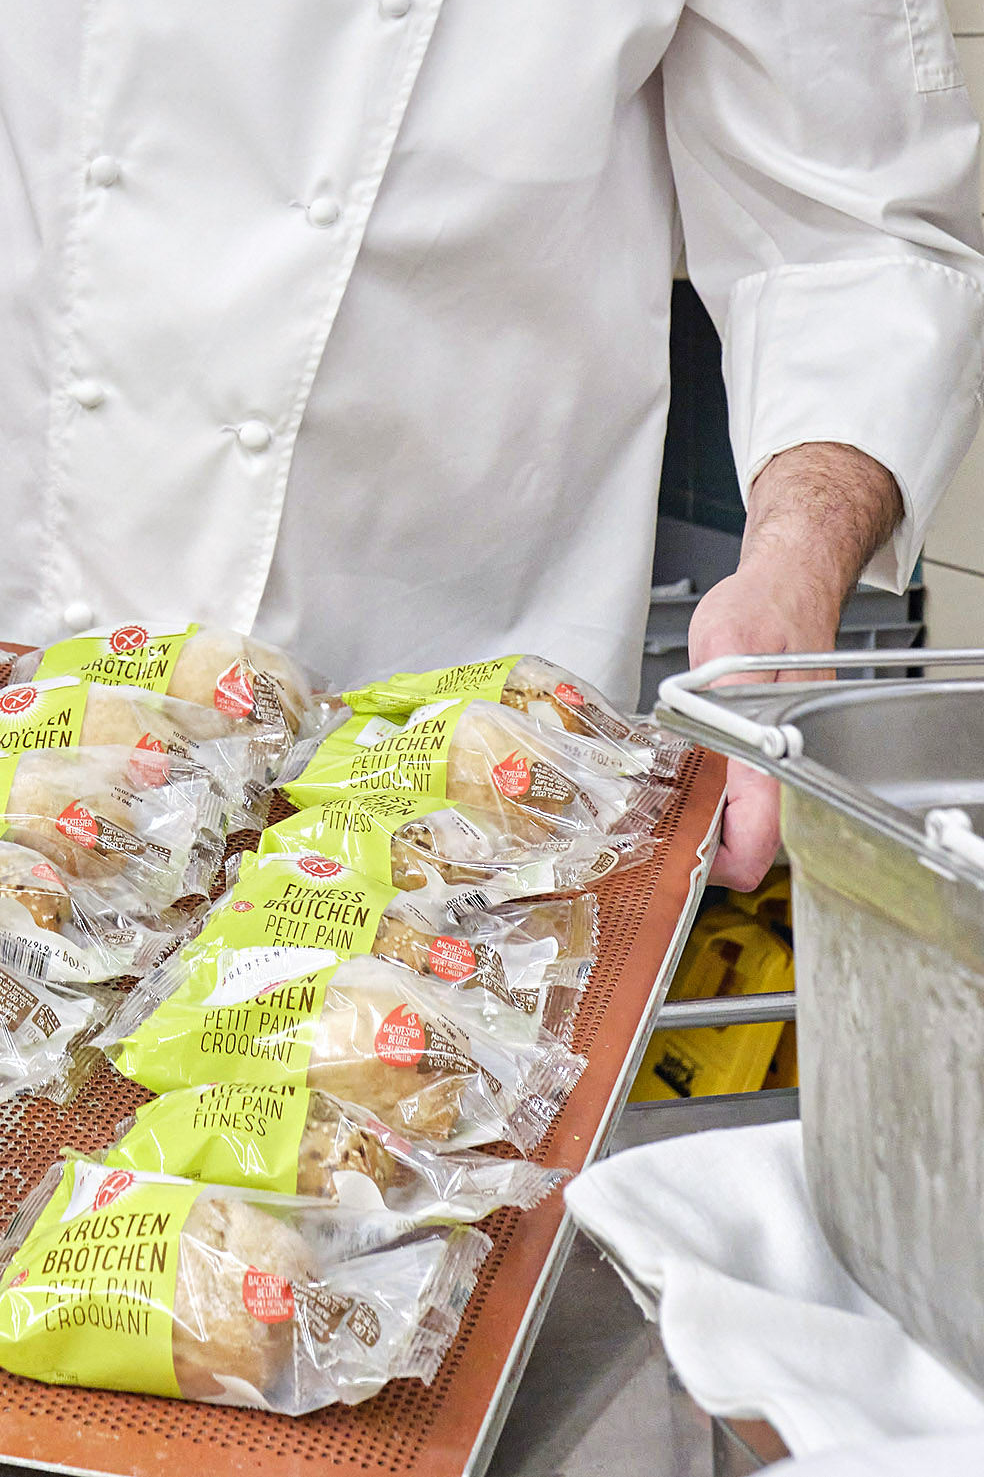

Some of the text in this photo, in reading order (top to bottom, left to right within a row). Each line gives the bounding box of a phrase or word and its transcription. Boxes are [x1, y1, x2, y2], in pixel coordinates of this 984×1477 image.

[352, 753, 432, 771] PETIT PAIN
[350, 770, 432, 792] CROQUANT
[321, 809, 374, 833] FITNESS
[283, 883, 366, 903] FITNESS
[264, 914, 310, 941] PETIT
[315, 925, 354, 950] PAIN
[436, 939, 473, 958] BACKFESTER
[204, 1008, 301, 1039] PETIT PAIN
[382, 1023, 421, 1039] BACKFESTER
[201, 1031, 296, 1064] CROQUANT
[387, 1034, 410, 1048] BEUTEL
[242, 1095, 284, 1120] PAIN
[193, 1112, 268, 1137] FITNESS
[58, 1213, 171, 1245] KRUSTEN
[42, 1241, 168, 1274] BRÖTCHEN
[46, 1277, 153, 1306] PETIT PAIN
[45, 1303, 152, 1337] CROQUANT
